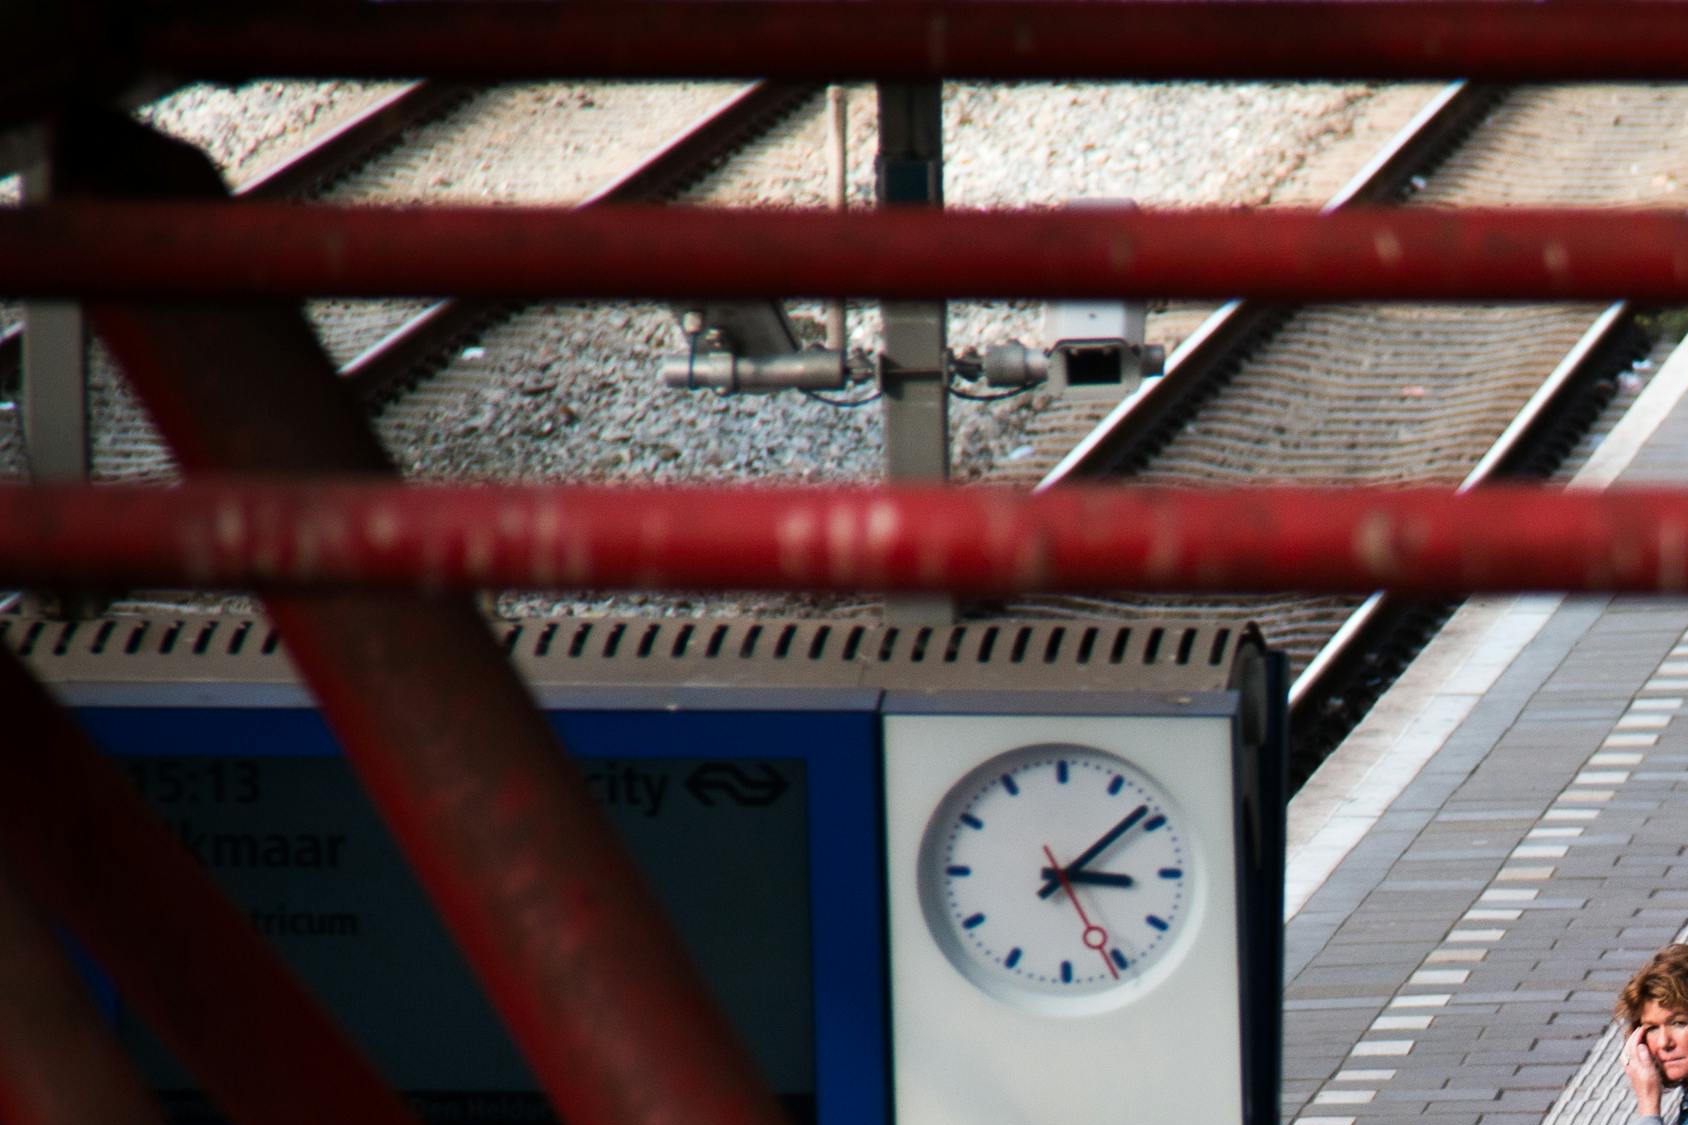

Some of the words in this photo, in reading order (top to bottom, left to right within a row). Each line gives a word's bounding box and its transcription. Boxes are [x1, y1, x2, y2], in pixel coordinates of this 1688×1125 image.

[584, 762, 668, 818] city
[172, 818, 345, 868] kmaar
[248, 905, 359, 936] tricum
